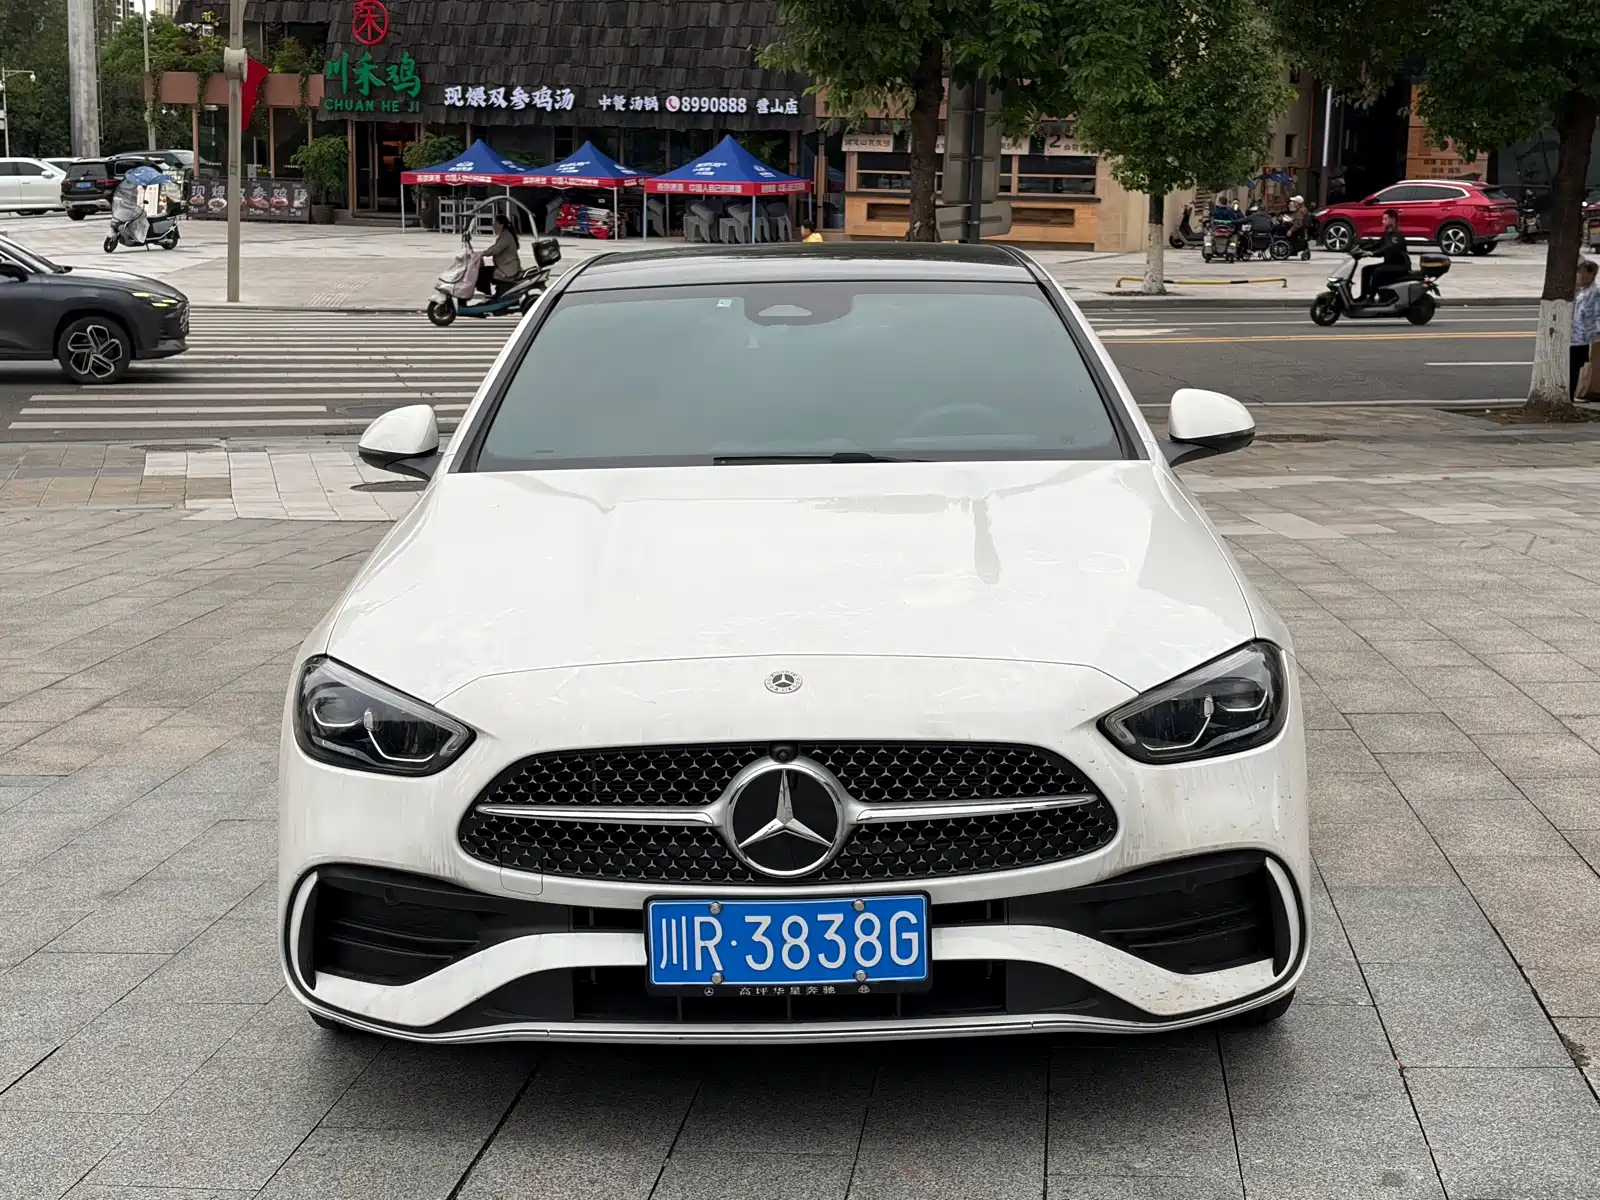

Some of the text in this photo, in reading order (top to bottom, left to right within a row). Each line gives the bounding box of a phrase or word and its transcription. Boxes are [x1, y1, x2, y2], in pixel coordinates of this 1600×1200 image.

[326, 51, 422, 98] 川禾鸡
[324, 99, 420, 113] CHUAN HE JI
[443, 85, 576, 112] 现煨双参鸡汤
[681, 96, 747, 113] 8990888
[756, 97, 799, 114] 营山店
[659, 910, 920, 971] 川R·3838G
[739, 985, 837, 996] 高坪华星奔驰
